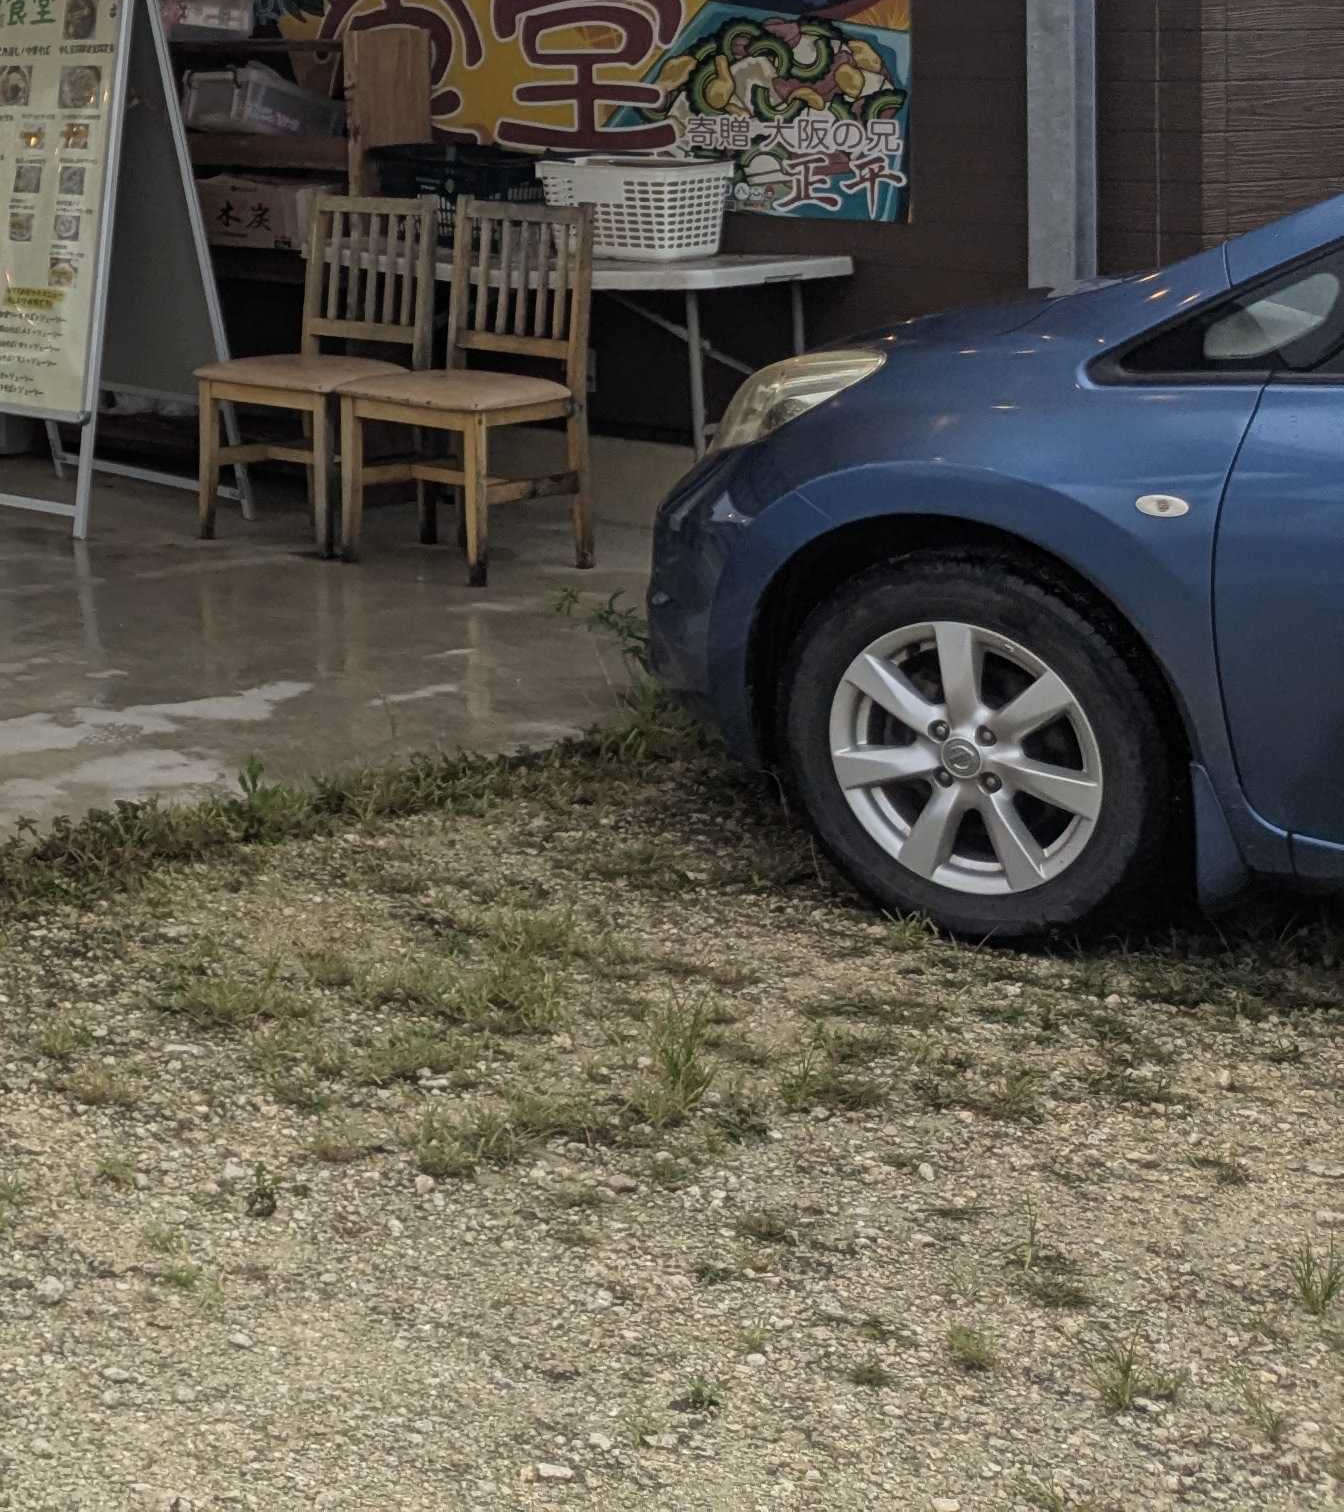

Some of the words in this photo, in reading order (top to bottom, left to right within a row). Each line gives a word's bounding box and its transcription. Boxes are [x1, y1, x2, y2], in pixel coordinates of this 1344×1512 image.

[686, 116, 751, 150] 寄贈
[762, 117, 903, 154] 大阪の兄
[772, 154, 908, 221] 正平
[216, 199, 273, 232] 木炭
